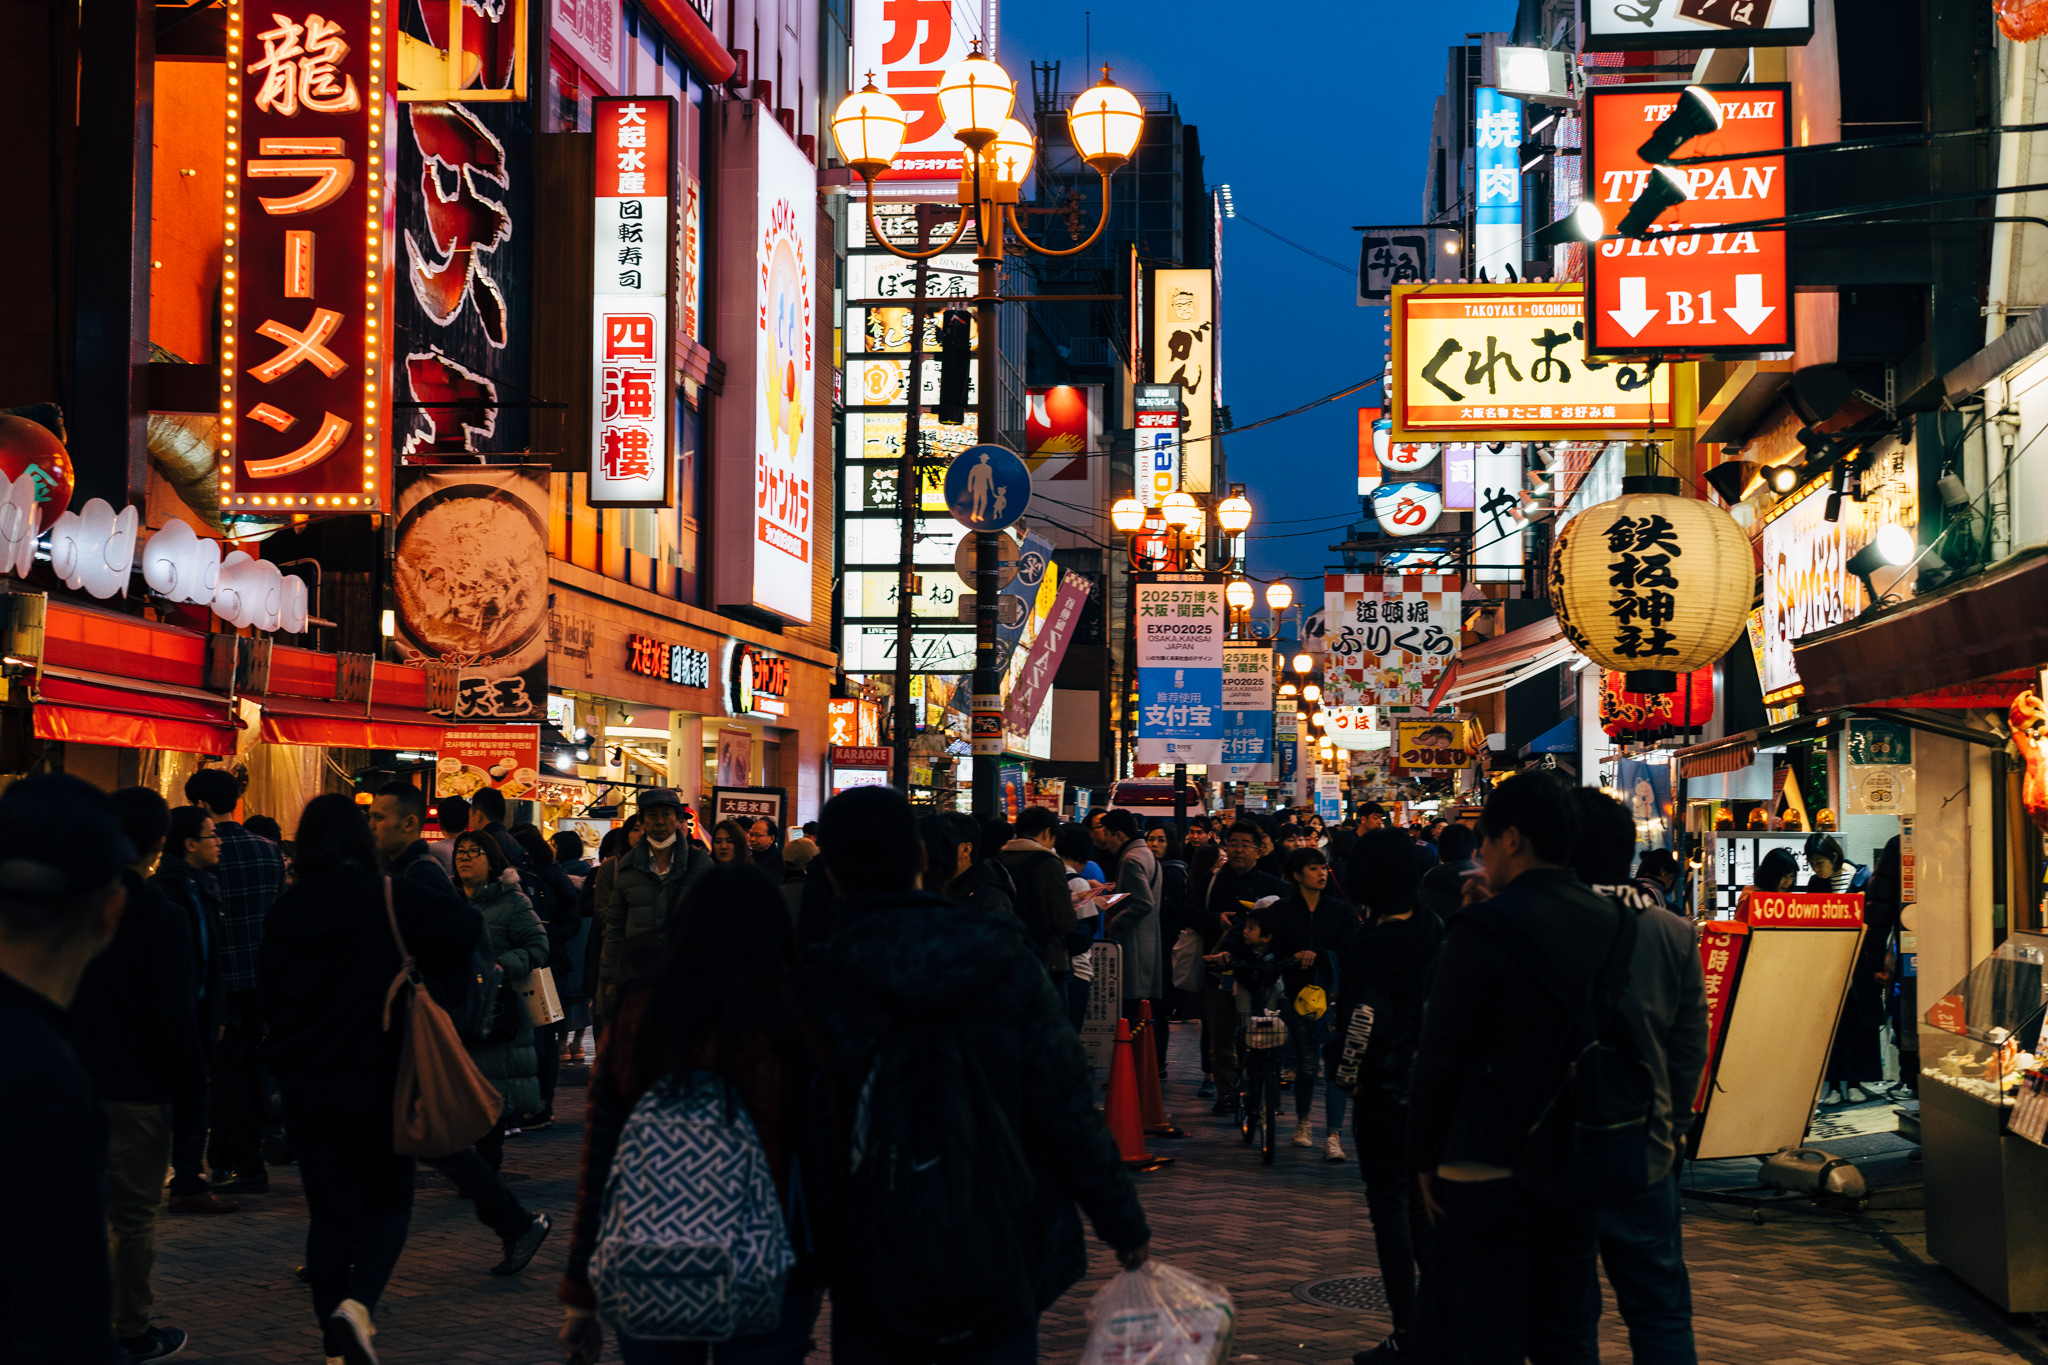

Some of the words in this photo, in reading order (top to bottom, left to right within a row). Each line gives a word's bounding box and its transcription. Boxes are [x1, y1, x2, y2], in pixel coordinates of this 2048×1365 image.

[1644, 102, 1775, 121] TENYAKI
[617, 103, 646, 194] 大起水産
[1476, 109, 1521, 203] 焼肉
[1603, 166, 1777, 202] TEPAN
[244, 13, 361, 478] 龍ラーメン
[618, 200, 643, 289] 回転寿司
[1368, 248, 1418, 284] 牛角
[1666, 290, 1717, 324] B1
[601, 313, 661, 481] 四海樓
[1461, 406, 1508, 418] 大阪名物
[758, 454, 809, 533] ジャンカラ
[1480, 487, 1517, 538] や
[1141, 591, 1218, 603] 2025万博を
[1601, 515, 1682, 658] 鉄板神社
[1141, 604, 1219, 618] 大阪・関西へ
[1356, 600, 1429, 623] 道頓堀
[1147, 625, 1212, 634] EXPO2025
[1332, 625, 1454, 656] ぷりくら
[631, 639, 670, 680] 大起水産
[1223, 654, 1269, 662] 25万博を
[1144, 704, 1212, 727] 支付宝
[836, 749, 887, 760] KARAOKE
[1221, 738, 1264, 754] 支付宝
[725, 800, 771, 813] 大起水産
[1763, 898, 1785, 919] GO
[1787, 899, 1820, 919] down
[1821, 900, 1852, 919] stairs.
